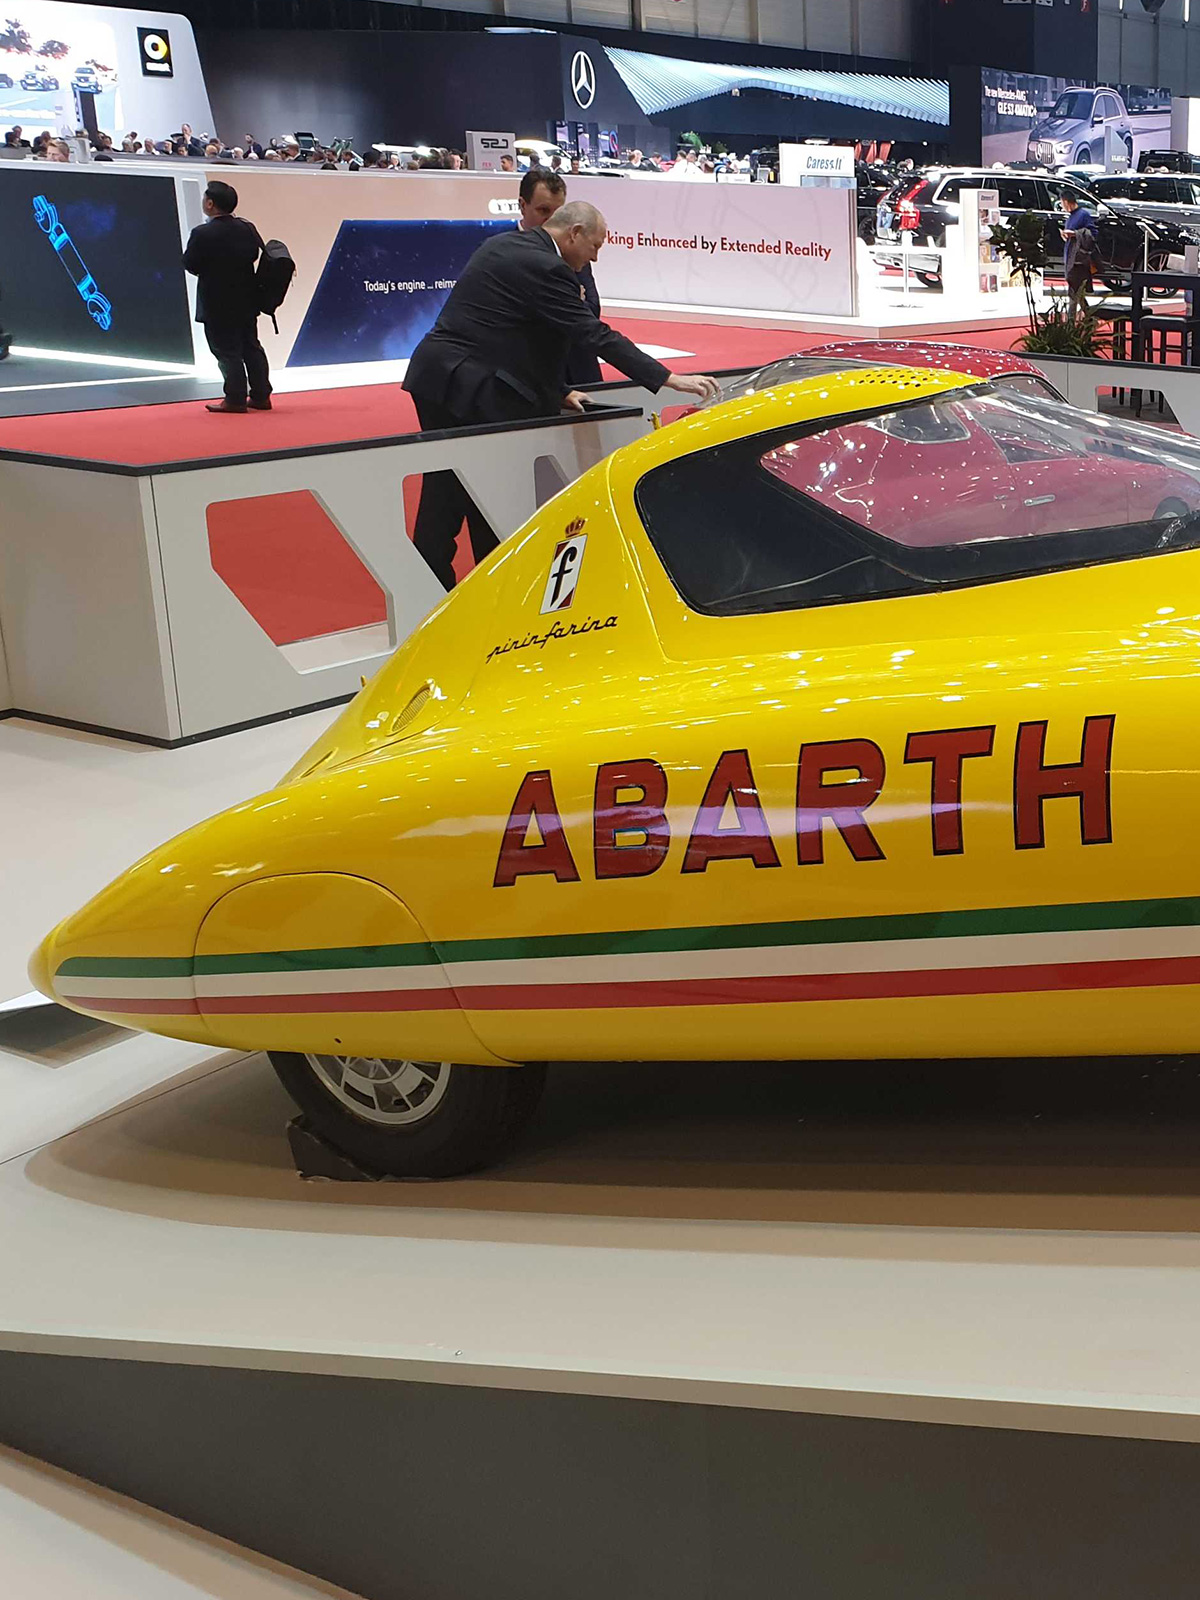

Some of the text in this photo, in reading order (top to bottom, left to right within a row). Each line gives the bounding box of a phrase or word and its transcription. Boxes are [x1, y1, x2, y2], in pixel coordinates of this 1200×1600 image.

[607, 230, 832, 261] king Enhanced by Extended Reality
[363, 280, 396, 294] Today's
[398, 279, 426, 293] engine
[485, 616, 619, 665] pininfarina
[493, 713, 1117, 888] ABARTH
